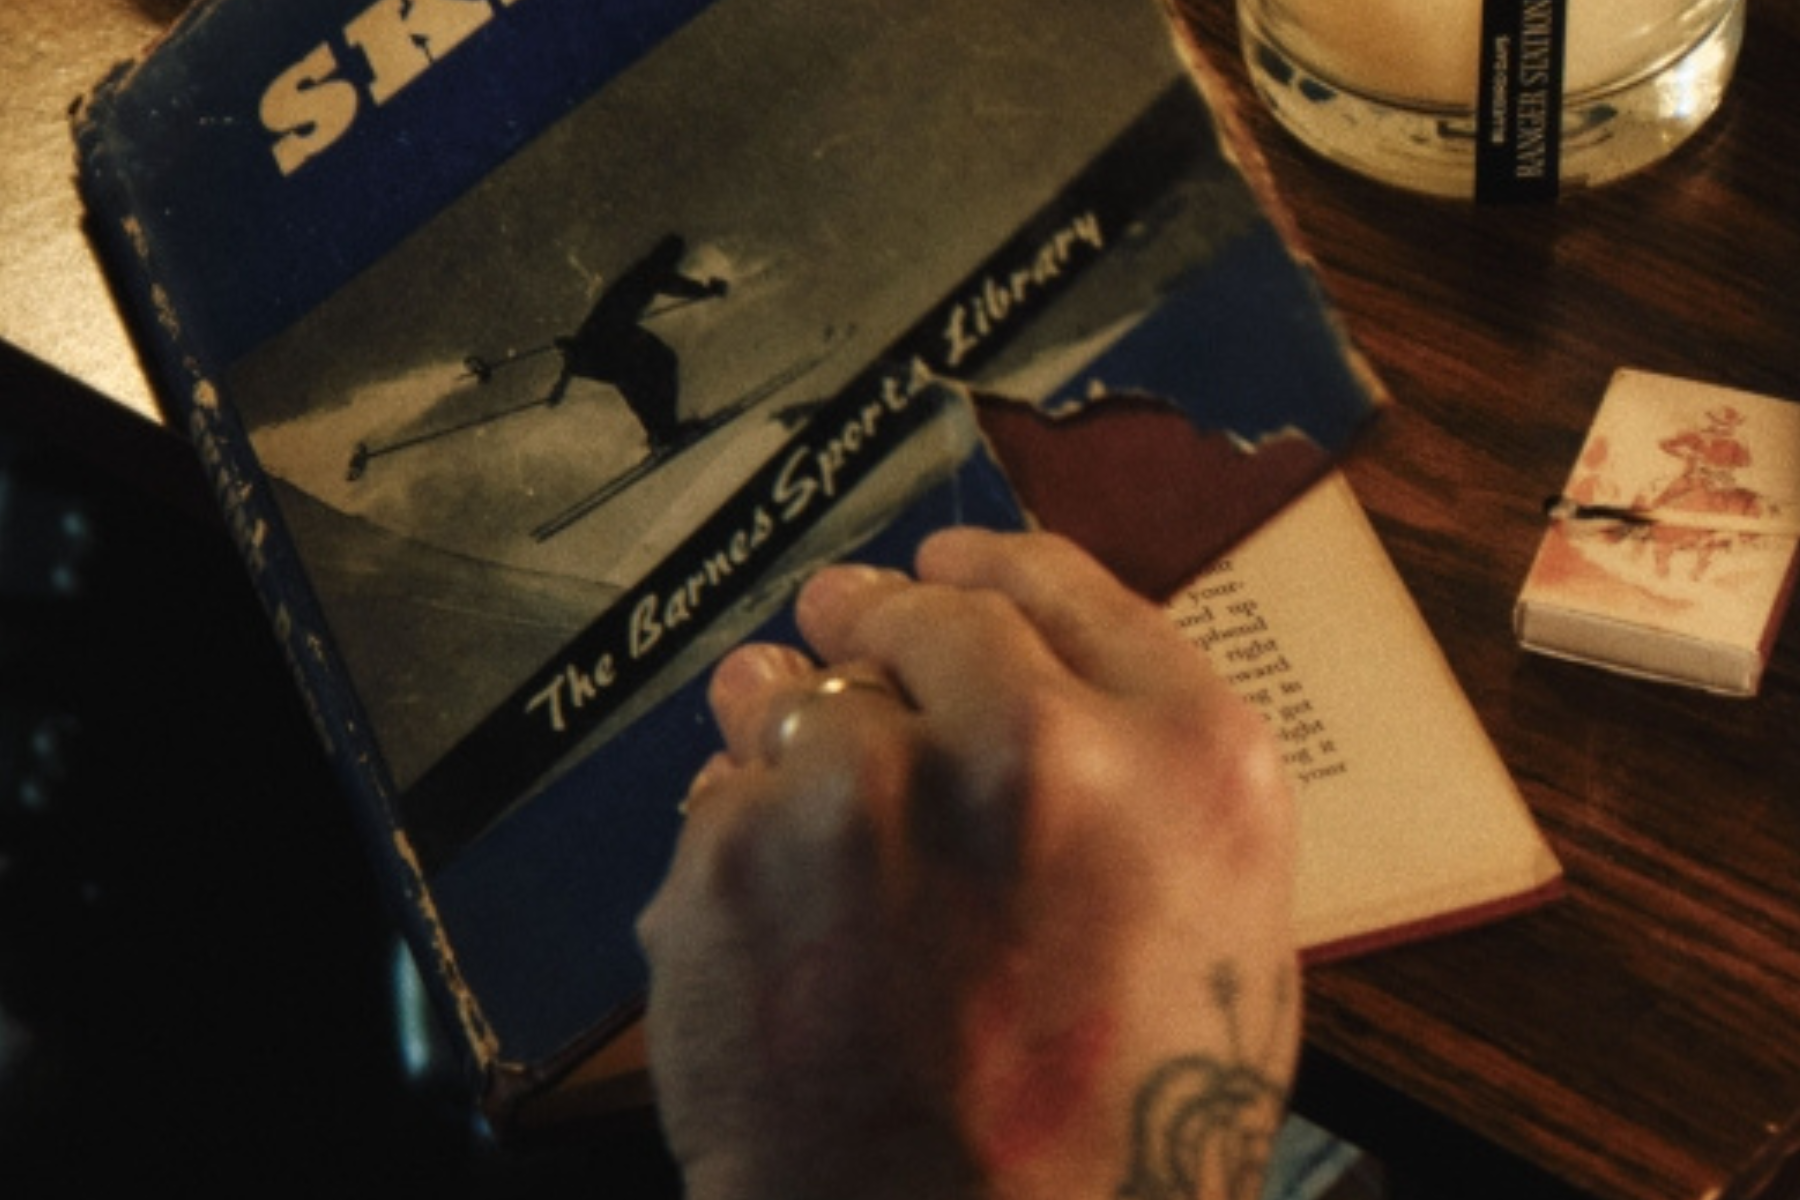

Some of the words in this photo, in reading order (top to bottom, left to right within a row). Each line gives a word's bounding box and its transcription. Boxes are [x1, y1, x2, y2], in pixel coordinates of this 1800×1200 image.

[1515, 90, 1547, 178] RANGER
[524, 653, 617, 731] The
[629, 505, 774, 659] Barnes
[772, 355, 932, 522] Sports
[944, 211, 1104, 366] Library
